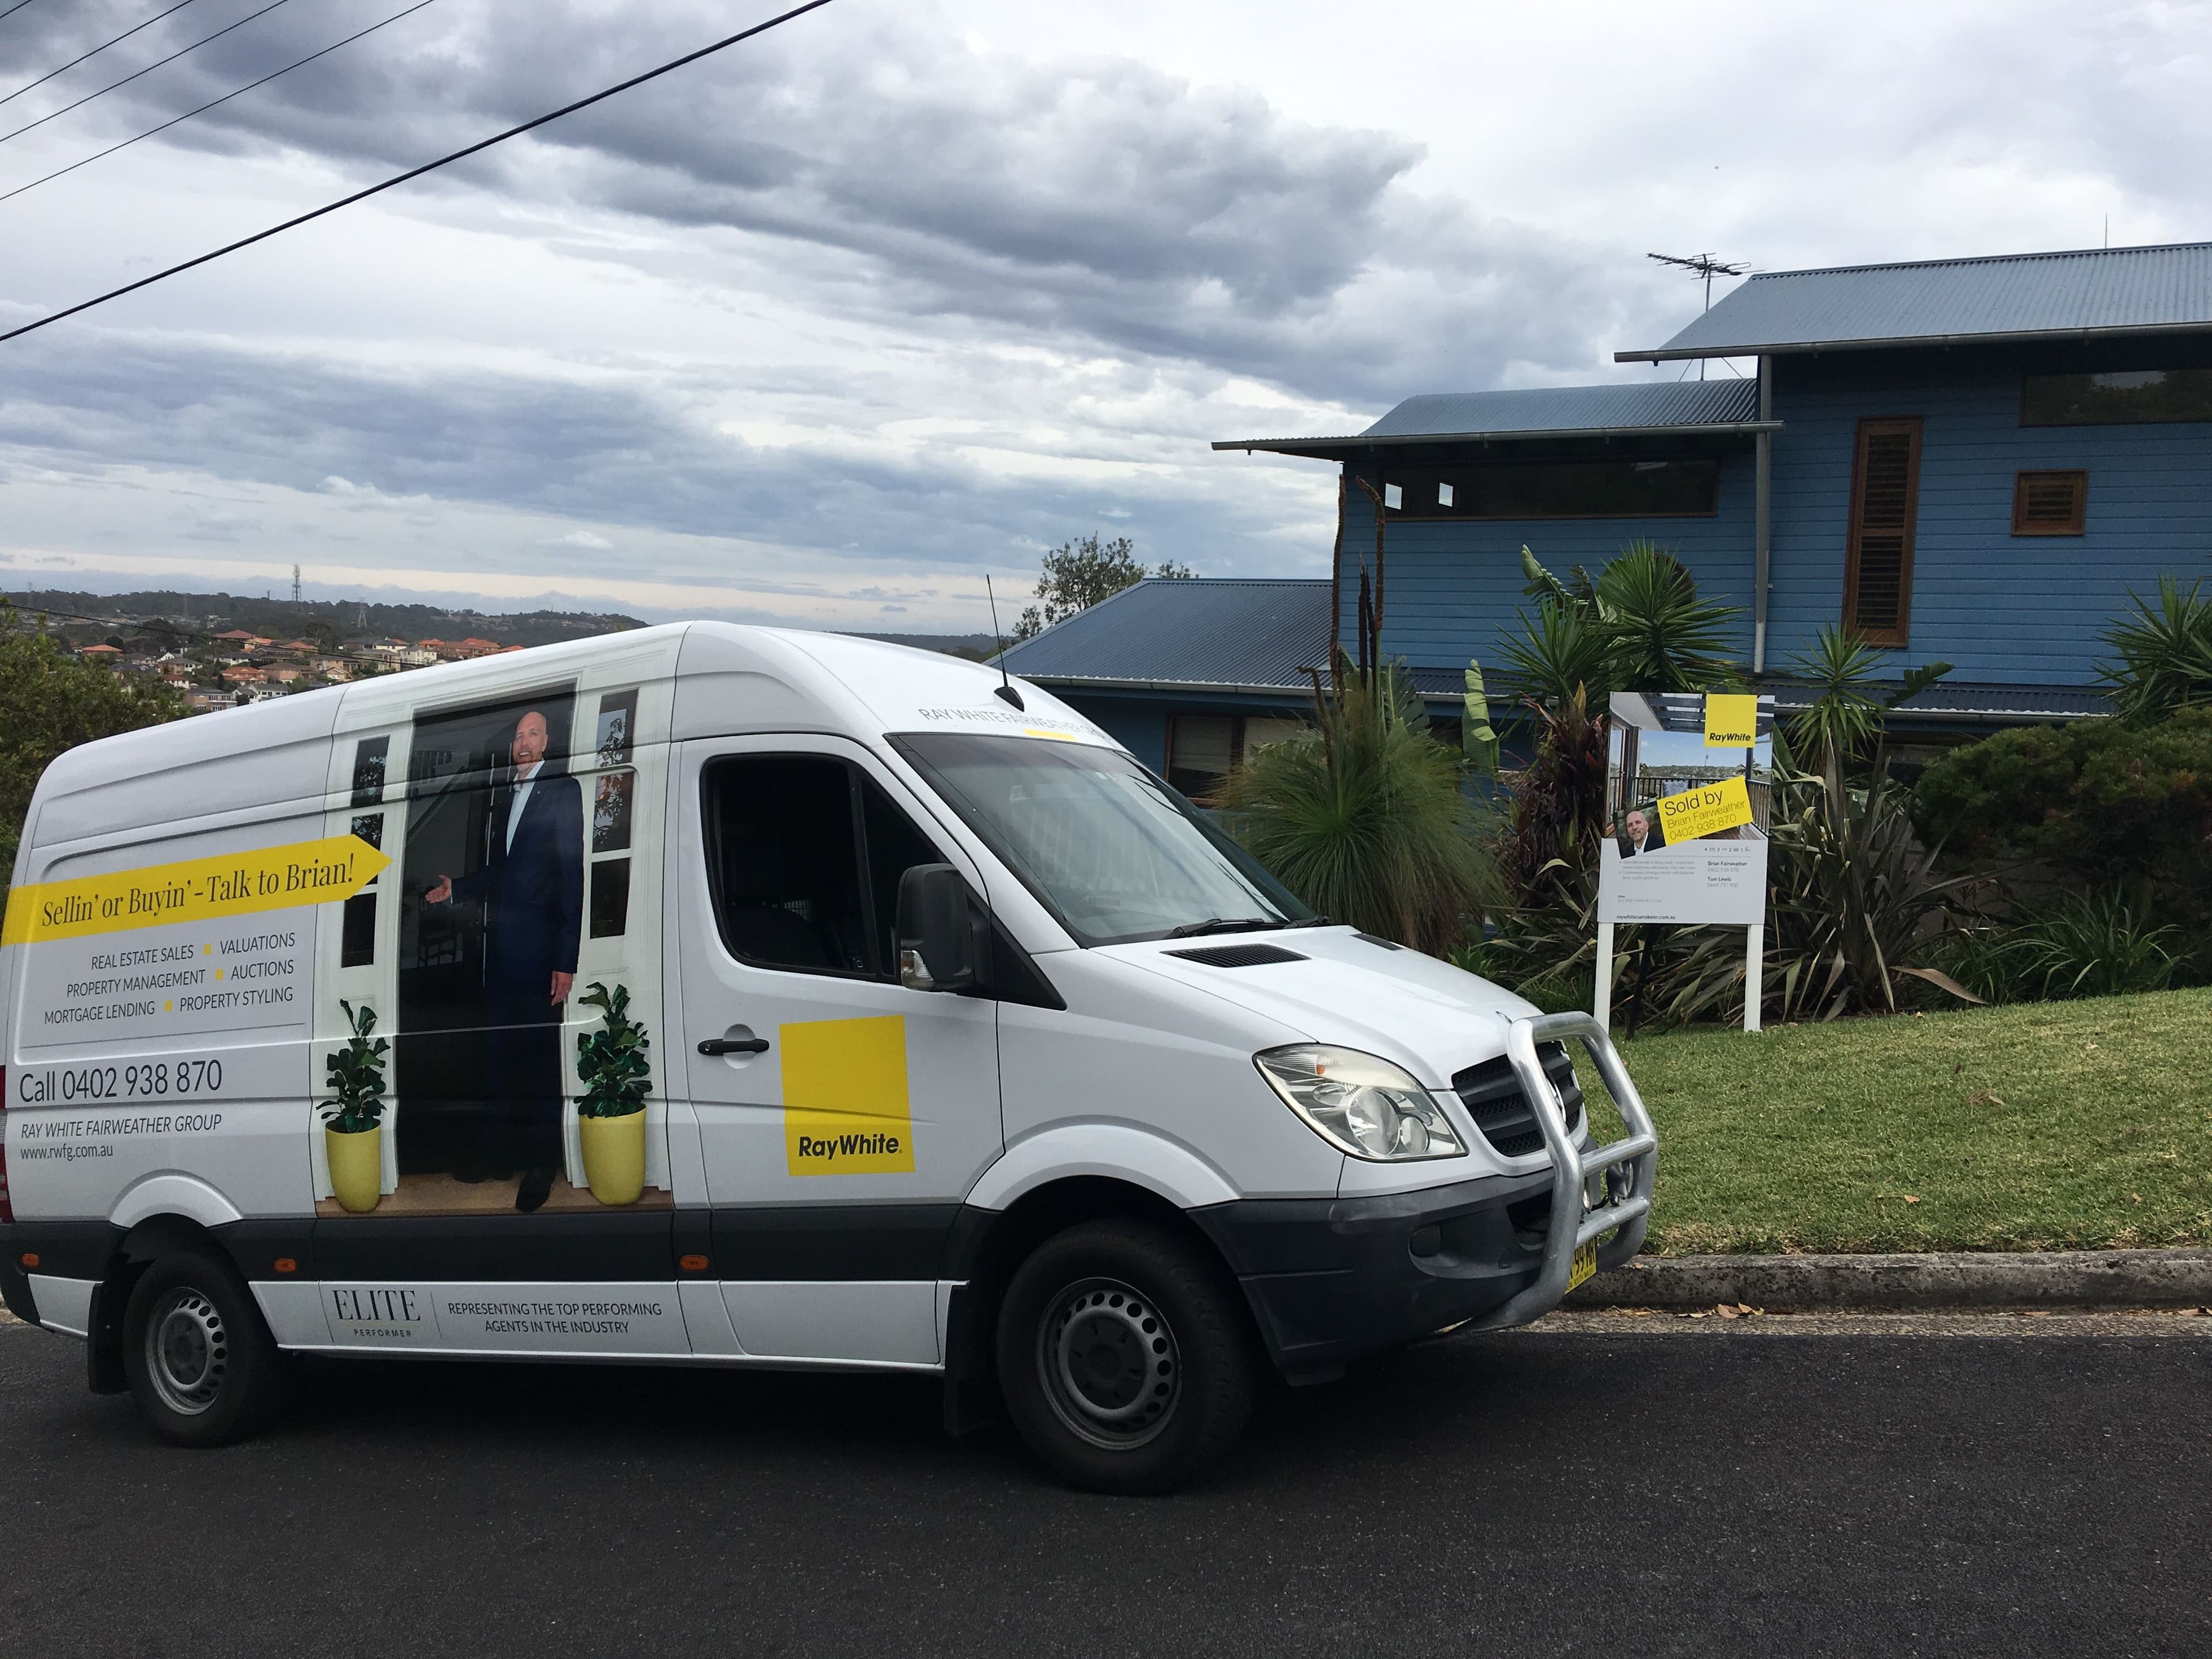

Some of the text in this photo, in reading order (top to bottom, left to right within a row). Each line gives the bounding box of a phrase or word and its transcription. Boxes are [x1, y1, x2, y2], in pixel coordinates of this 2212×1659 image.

[918, 709, 952, 720] RAY
[950, 710, 1006, 722] WHITE
[1664, 790, 1722, 816] Sold by
[1667, 801, 1745, 829] Brian Fairweather
[1669, 814, 1737, 840] 0402 938 870
[102, 896, 123, 918] or
[258, 870, 279, 895] to
[285, 853, 354, 892] Brian!
[92, 933, 295, 970] REAL ESTATE SALES VALUATIONS
[67, 960, 294, 997] PROPERTY MANAGEMENT AUCTIONS
[44, 987, 293, 1024] MORTGAGE LENDING PROPERTY STYLING
[20, 1059, 222, 1103] Call 0402 938 870
[21, 1114, 222, 1139] RAY WHITE FAIRWEATHER GROUP
[20, 1143, 113, 1161] www.rwfg.com.au
[332, 1290, 421, 1321] ELITE
[448, 1302, 662, 1316] REPRESENTING THE TOP PERFORMING
[354, 1328, 411, 1337] PERFORMER
[485, 1320, 629, 1333] AGENTS IN THE INDUSTRY
